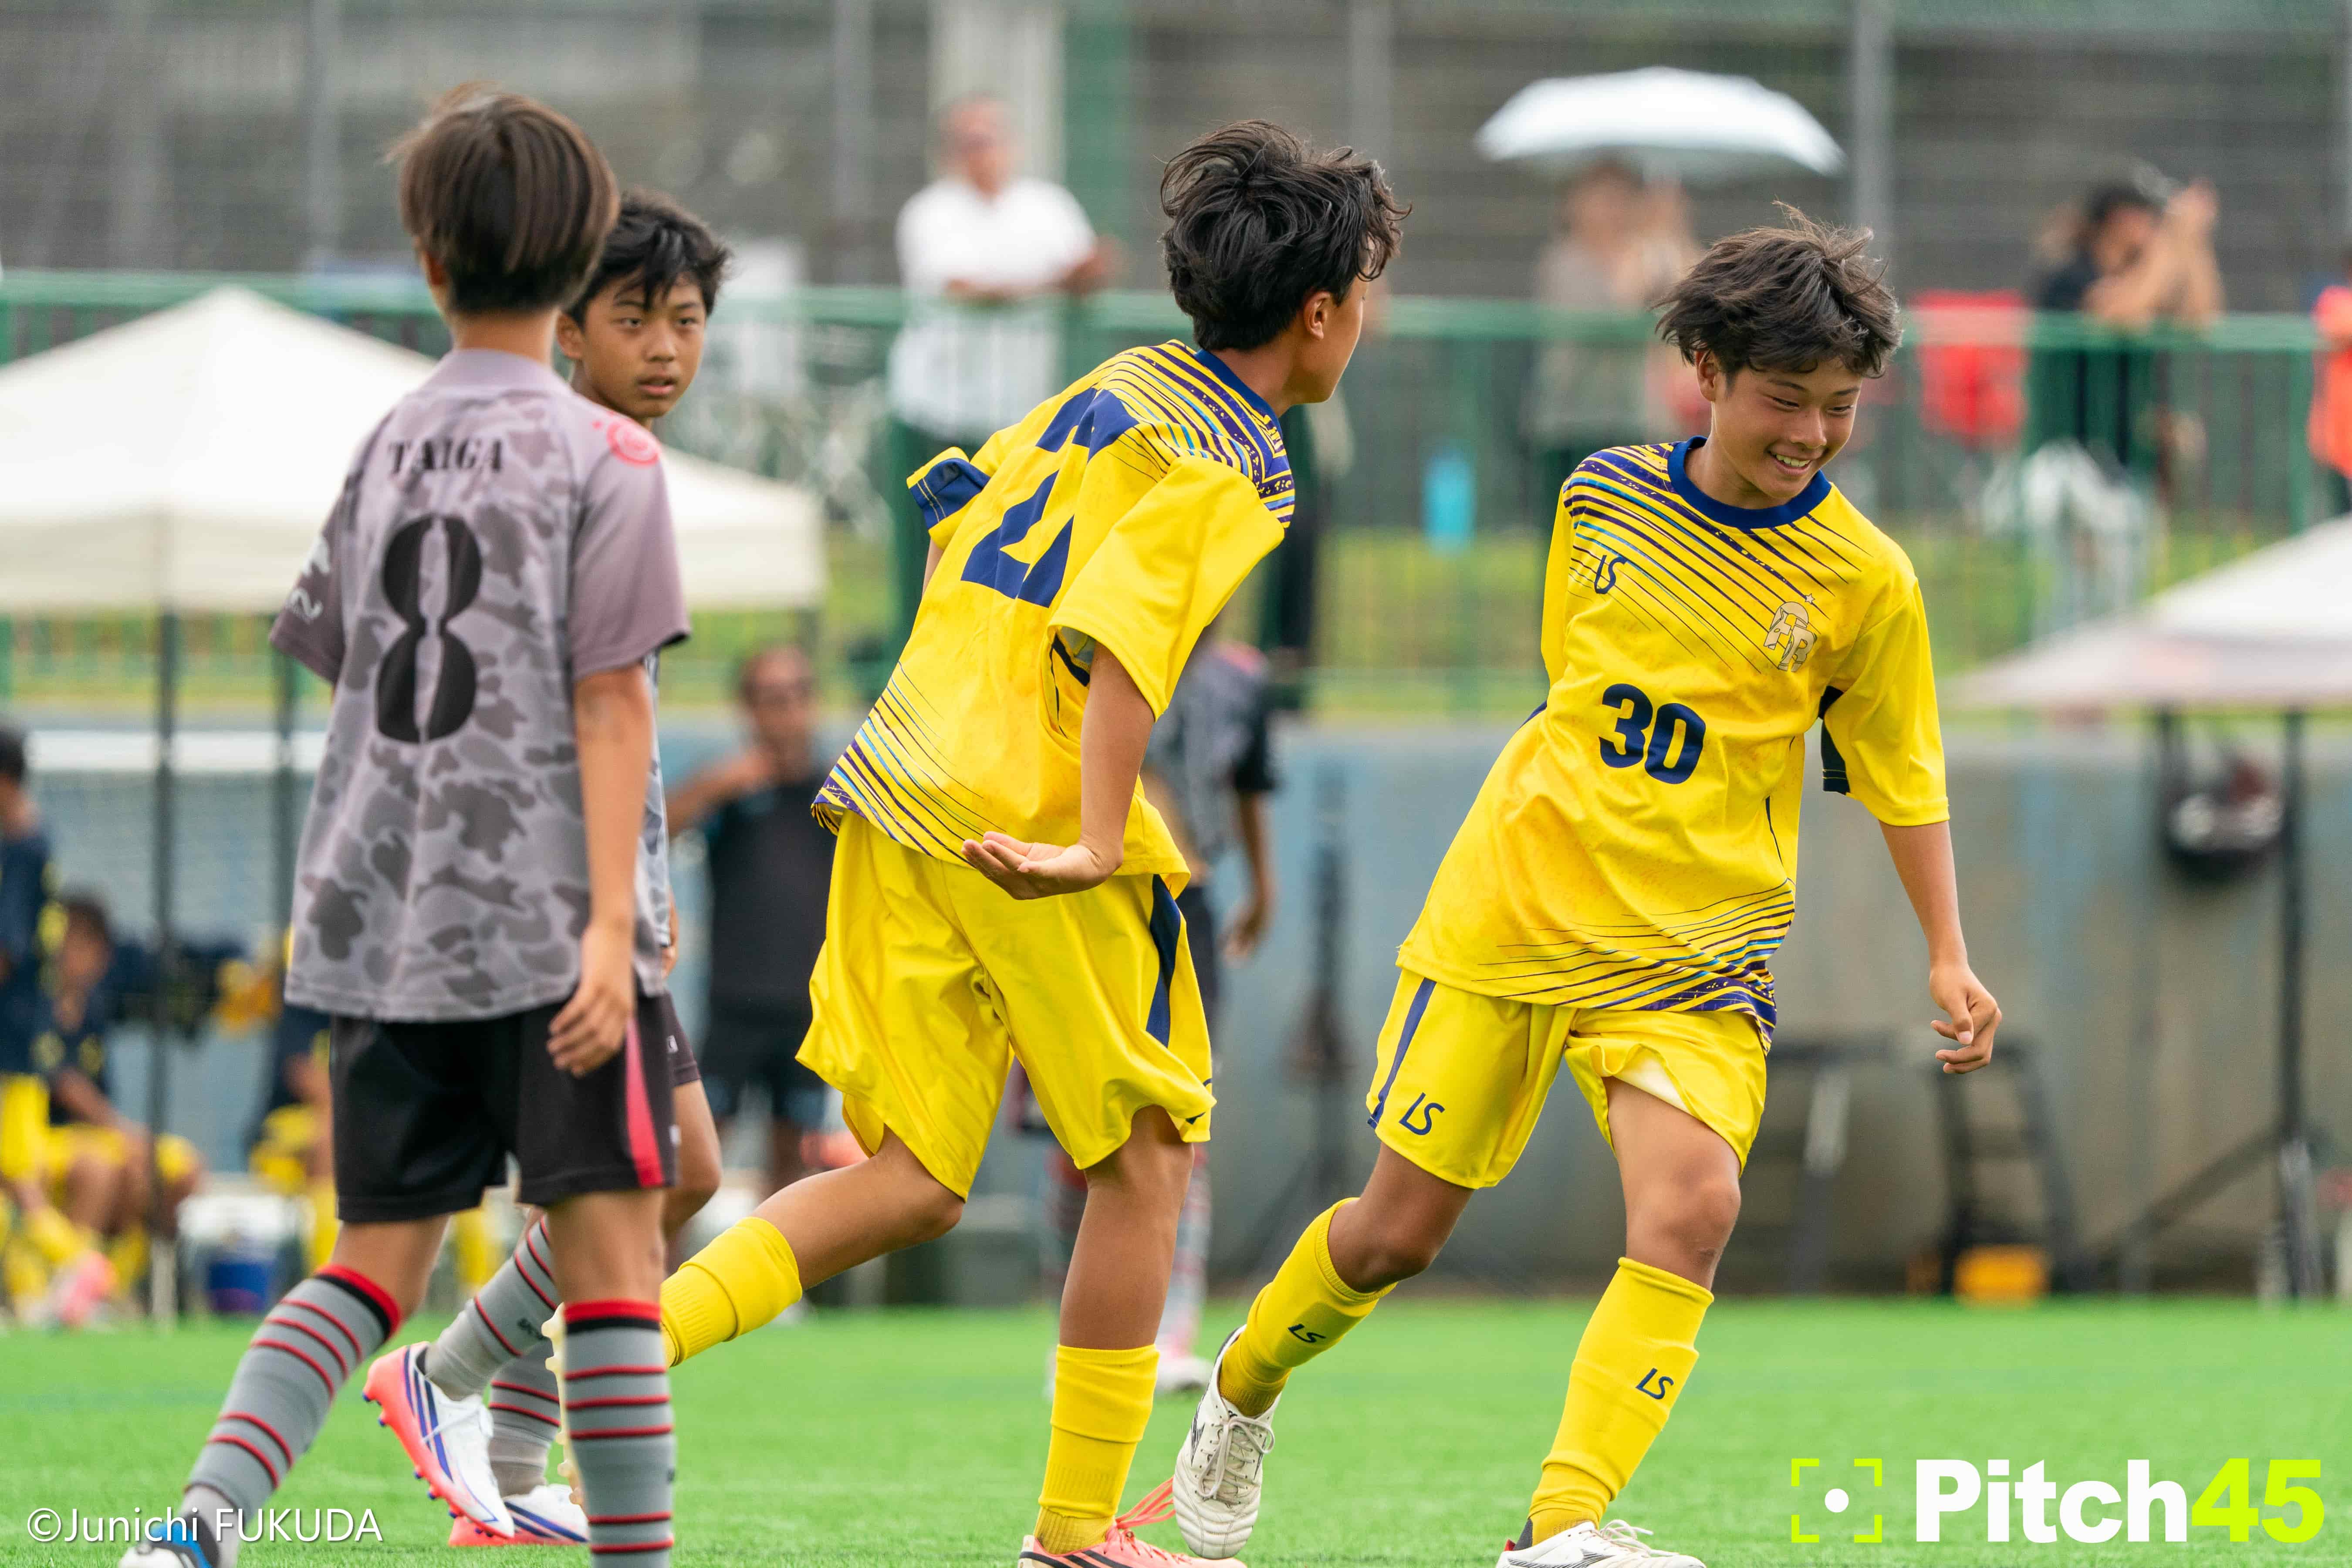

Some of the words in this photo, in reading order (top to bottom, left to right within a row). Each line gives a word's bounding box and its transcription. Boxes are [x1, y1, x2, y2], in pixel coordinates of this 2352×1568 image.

[388, 437, 504, 474] TAIGA
[374, 514, 483, 743] 8
[1598, 683, 1706, 784] 30
[1399, 1092, 1445, 1135] LS
[1288, 1323, 1326, 1344] LS
[1635, 1368, 1674, 1400] LS
